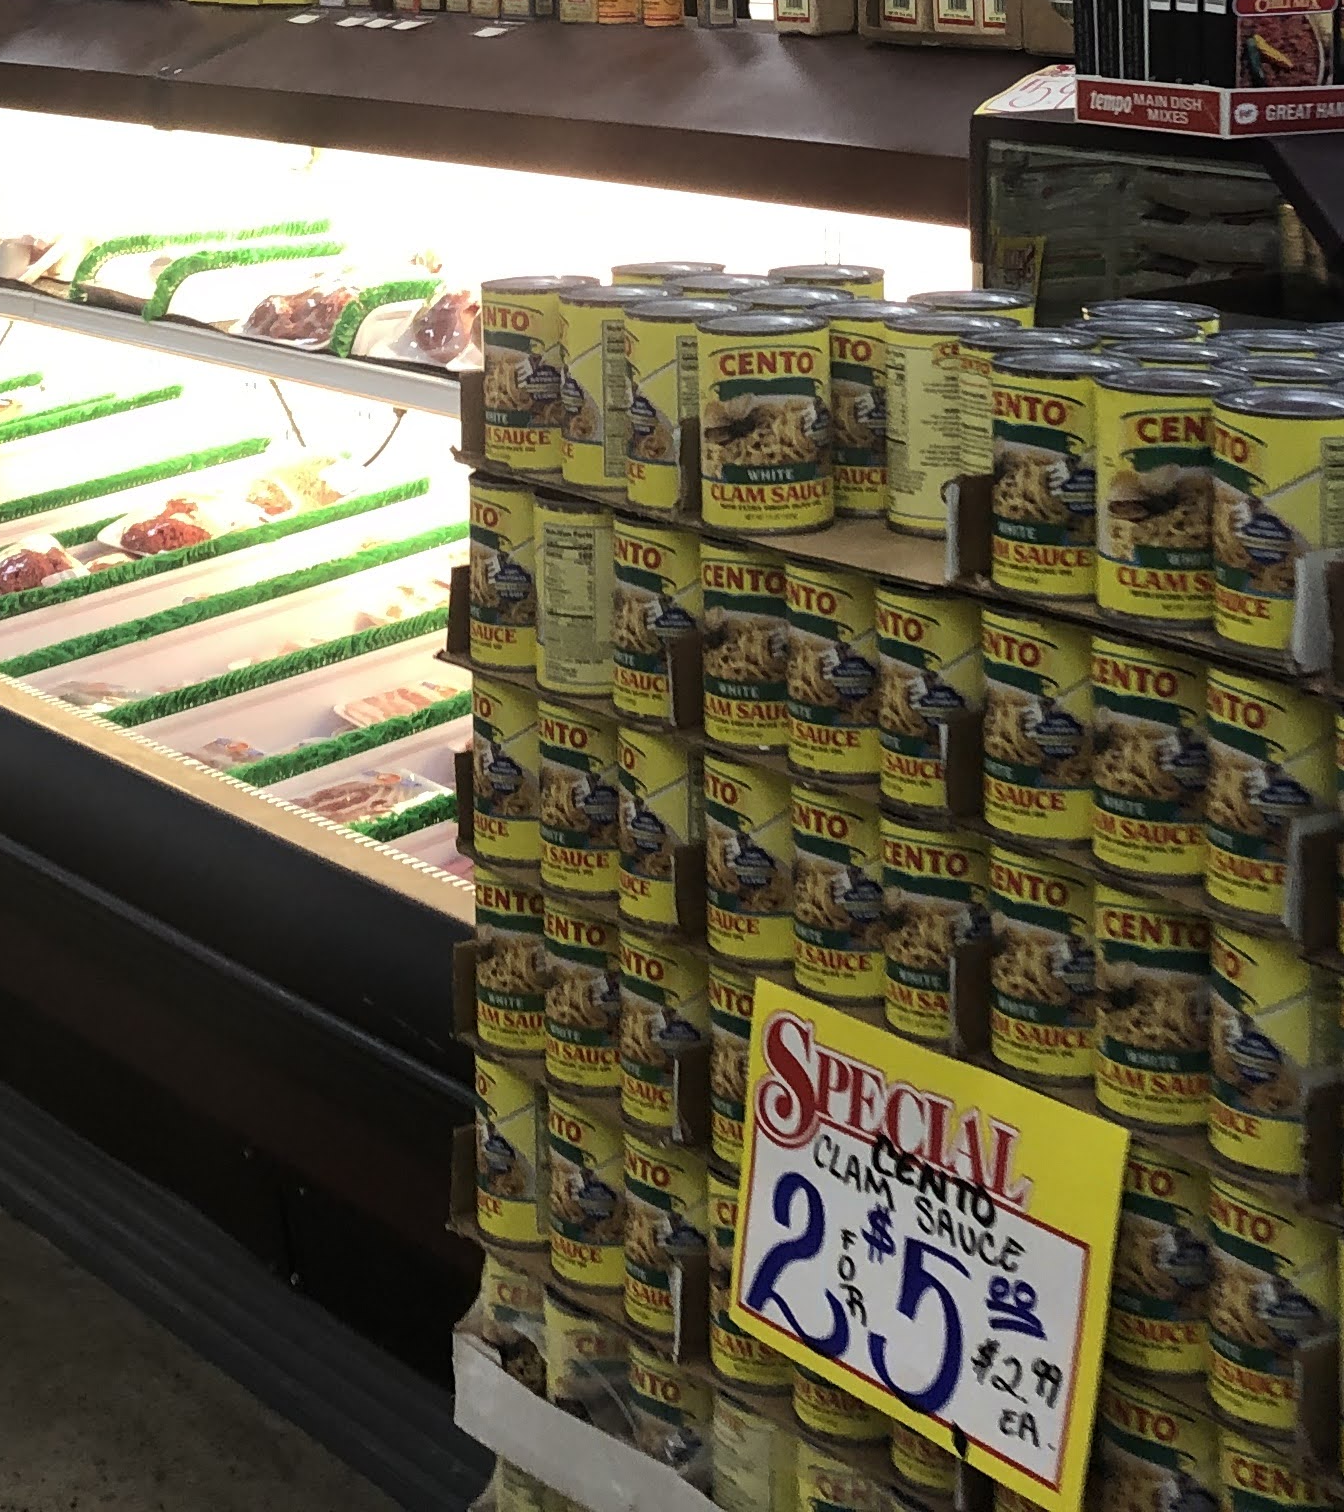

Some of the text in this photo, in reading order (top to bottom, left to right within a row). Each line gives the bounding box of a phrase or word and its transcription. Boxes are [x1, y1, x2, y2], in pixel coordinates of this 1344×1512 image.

[1089, 90, 1203, 115] tempo MAIN DISH
[1147, 108, 1190, 125] MIXES
[1265, 103, 1312, 122] GREAT
[484, 306, 529, 331] NTO
[719, 350, 814, 377] CENTO
[993, 391, 1066, 426] ENTO
[494, 428, 551, 446] SAUCE
[1137, 416, 1212, 444] CEN
[747, 469, 794, 481] WHITE
[711, 484, 766, 503] CLAM
[615, 541, 662, 570] NTO
[1015, 546, 1093, 568] SAUCE
[702, 563, 787, 594] CENTO
[788, 586, 837, 616] NTO
[878, 606, 925, 642] NTO
[984, 632, 1042, 668] NTO
[620, 670, 669, 693] SAUC
[1094, 656, 1179, 698] ENTO
[1209, 690, 1268, 730] NTO
[540, 718, 588, 749] NTO
[794, 725, 861, 748] SAUCE
[886, 754, 945, 780] SAUC
[996, 784, 1066, 811] SAUCE
[793, 807, 850, 841] NTO
[1122, 821, 1202, 846] SAUCE
[991, 864, 1070, 908] ENTO
[546, 912, 606, 947] ENTO
[1103, 910, 1210, 950] CENTO
[620, 946, 664, 982] NTO
[710, 986, 754, 1017] NTO
[562, 1044, 621, 1066] SAUC
[755, 1012, 1033, 1211] SPECIAL
[627, 1149, 672, 1187] NTO
[873, 1135, 997, 1226] CENTO
[813, 1134, 1027, 1272] CLAM SAUCE
[745, 1171, 850, 1358] 2
[838, 1228, 868, 1327] FOR
